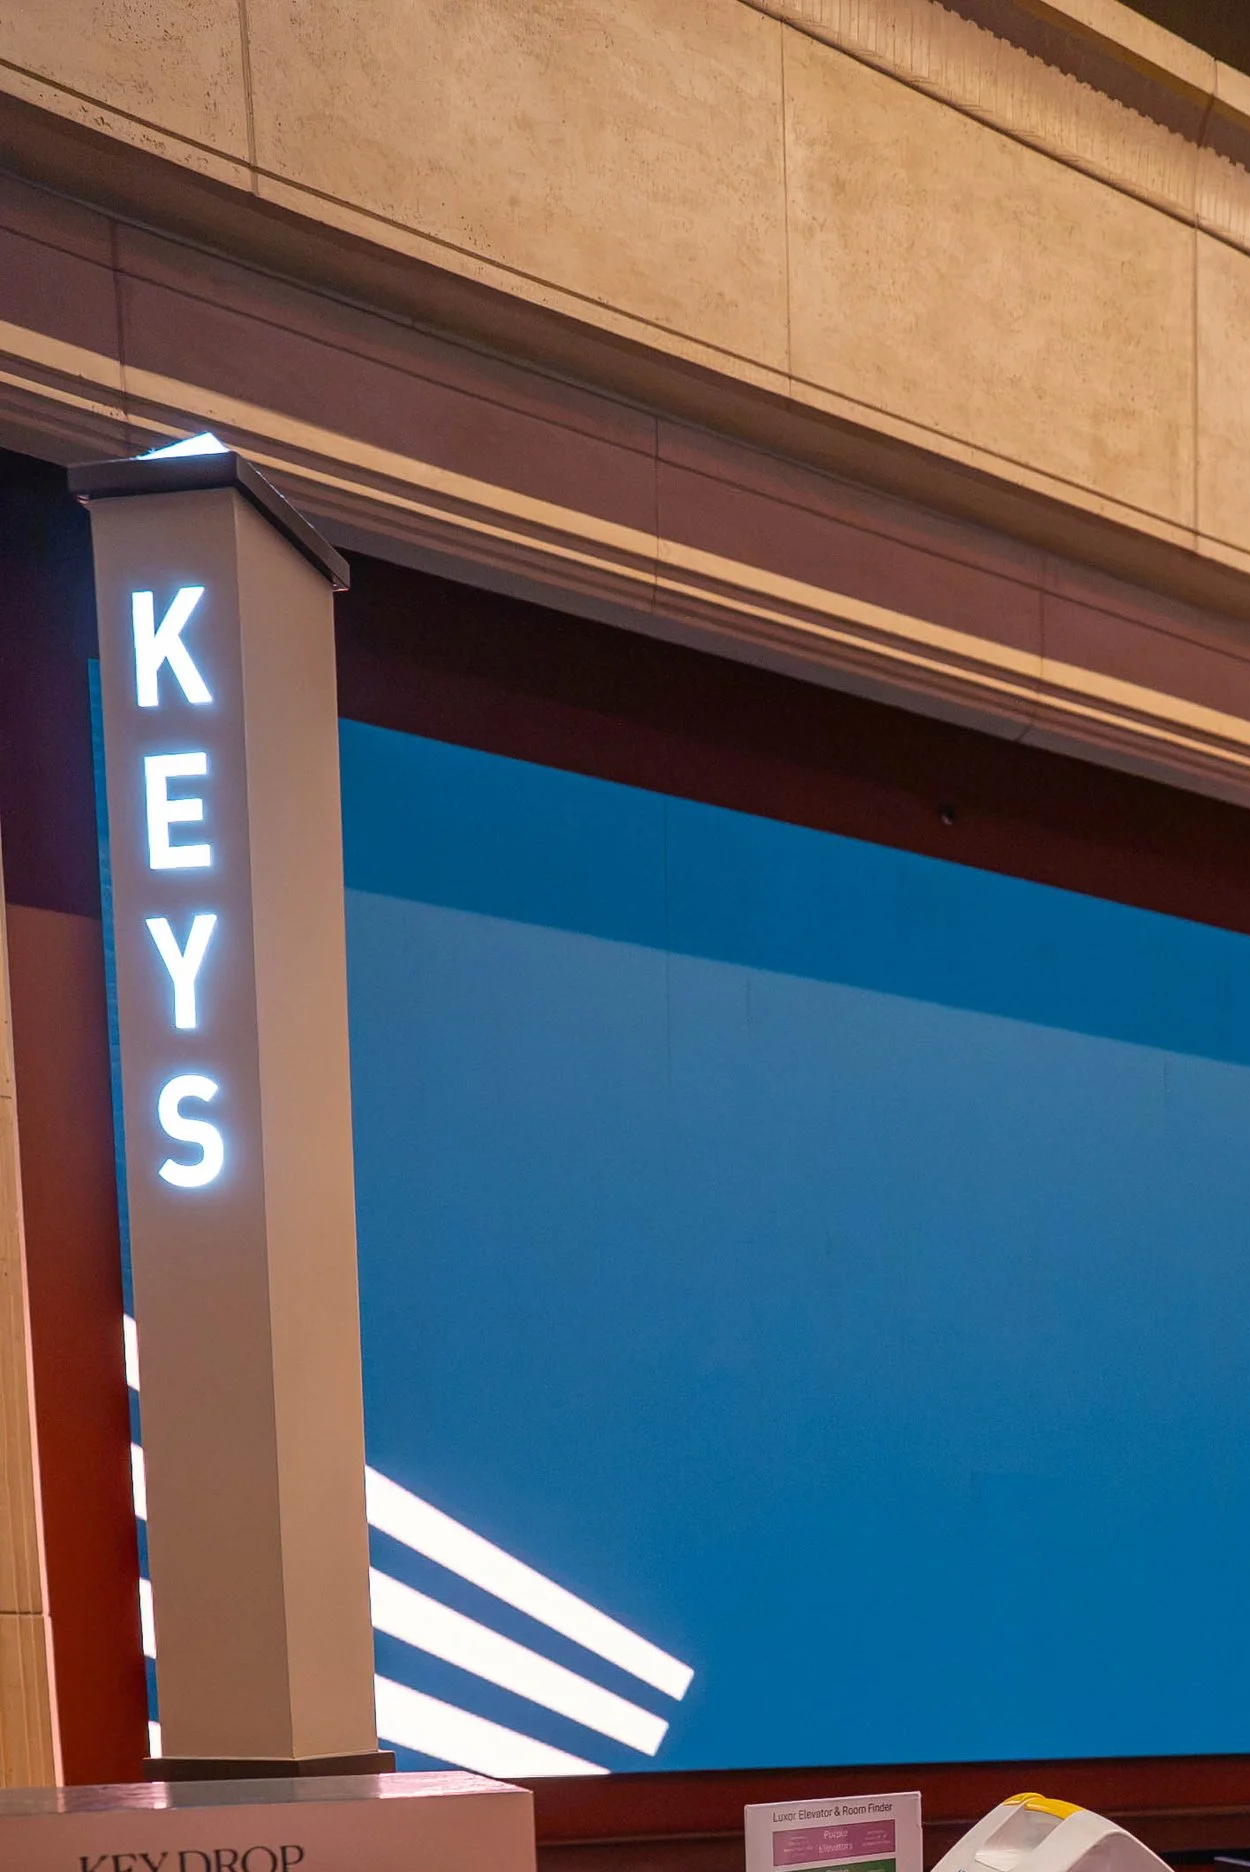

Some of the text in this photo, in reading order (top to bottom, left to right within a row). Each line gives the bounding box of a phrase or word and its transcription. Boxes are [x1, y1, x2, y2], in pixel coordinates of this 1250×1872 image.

[130, 585, 226, 1190] KEYS
[773, 1802, 893, 1823] Luxor Elevator & Room Finder
